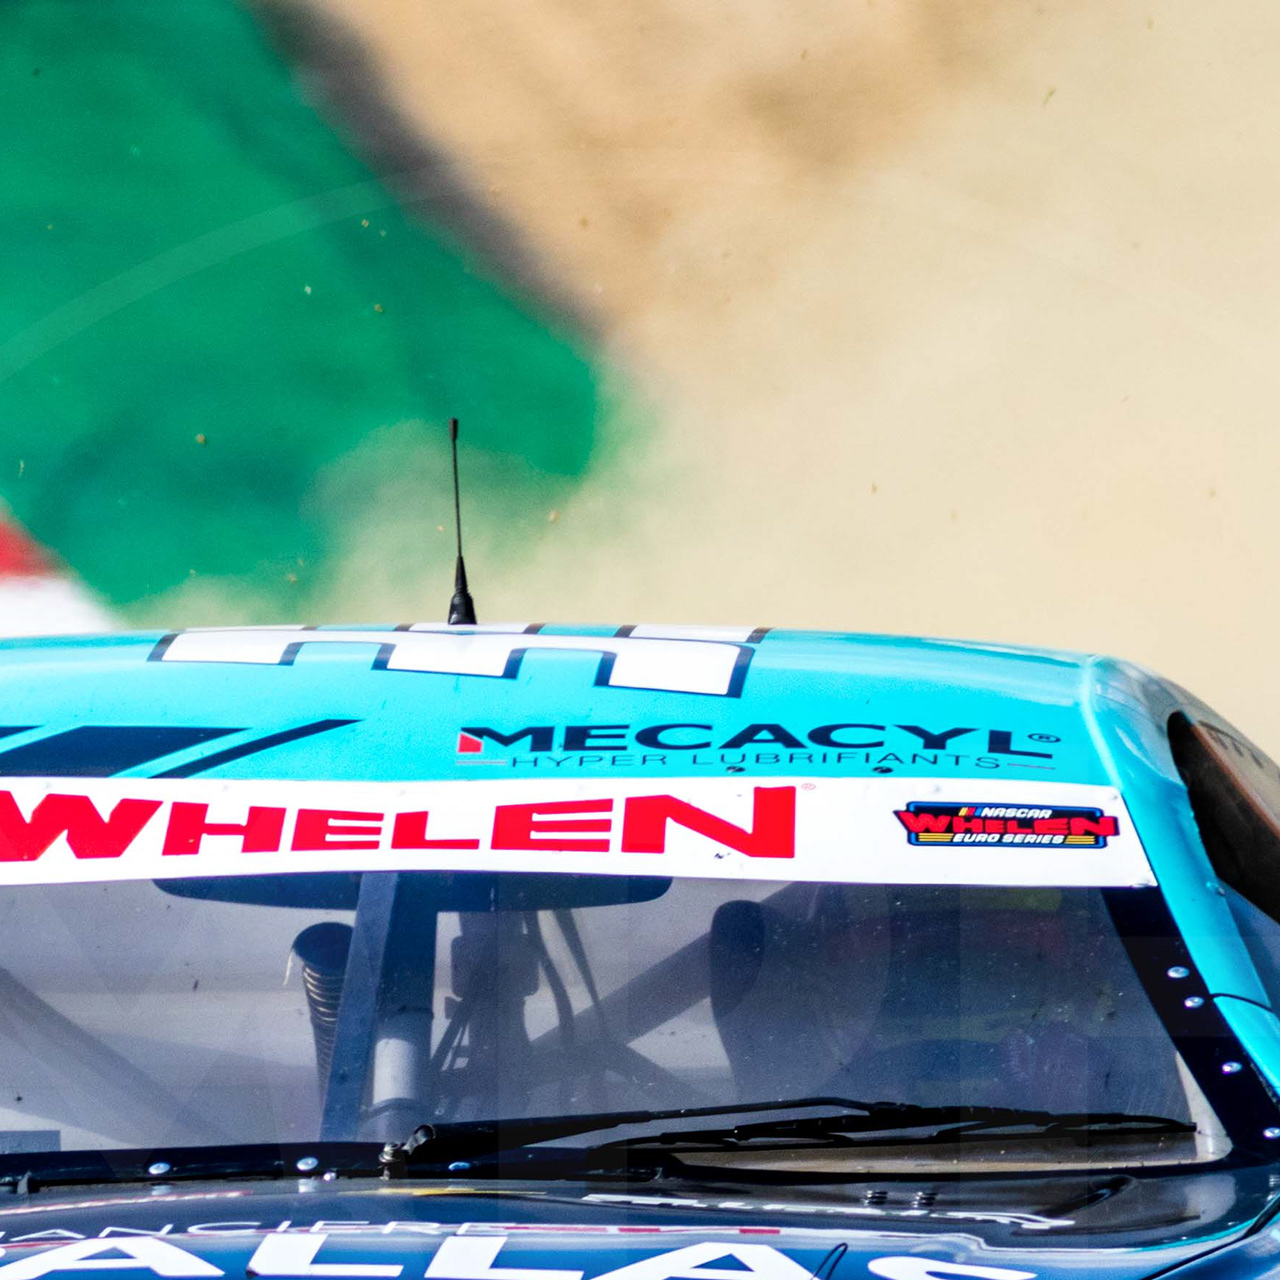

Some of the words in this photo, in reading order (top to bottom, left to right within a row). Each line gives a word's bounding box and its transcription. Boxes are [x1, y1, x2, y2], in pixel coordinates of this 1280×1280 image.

[512, 753, 667, 768] HYPER
[692, 752, 1001, 769] LUBRIFIANTS
[980, 807, 1053, 819] NASCAR
[896, 810, 1117, 837] WHELEN
[952, 833, 1000, 844] EURO
[1001, 833, 1066, 845] SERIES
